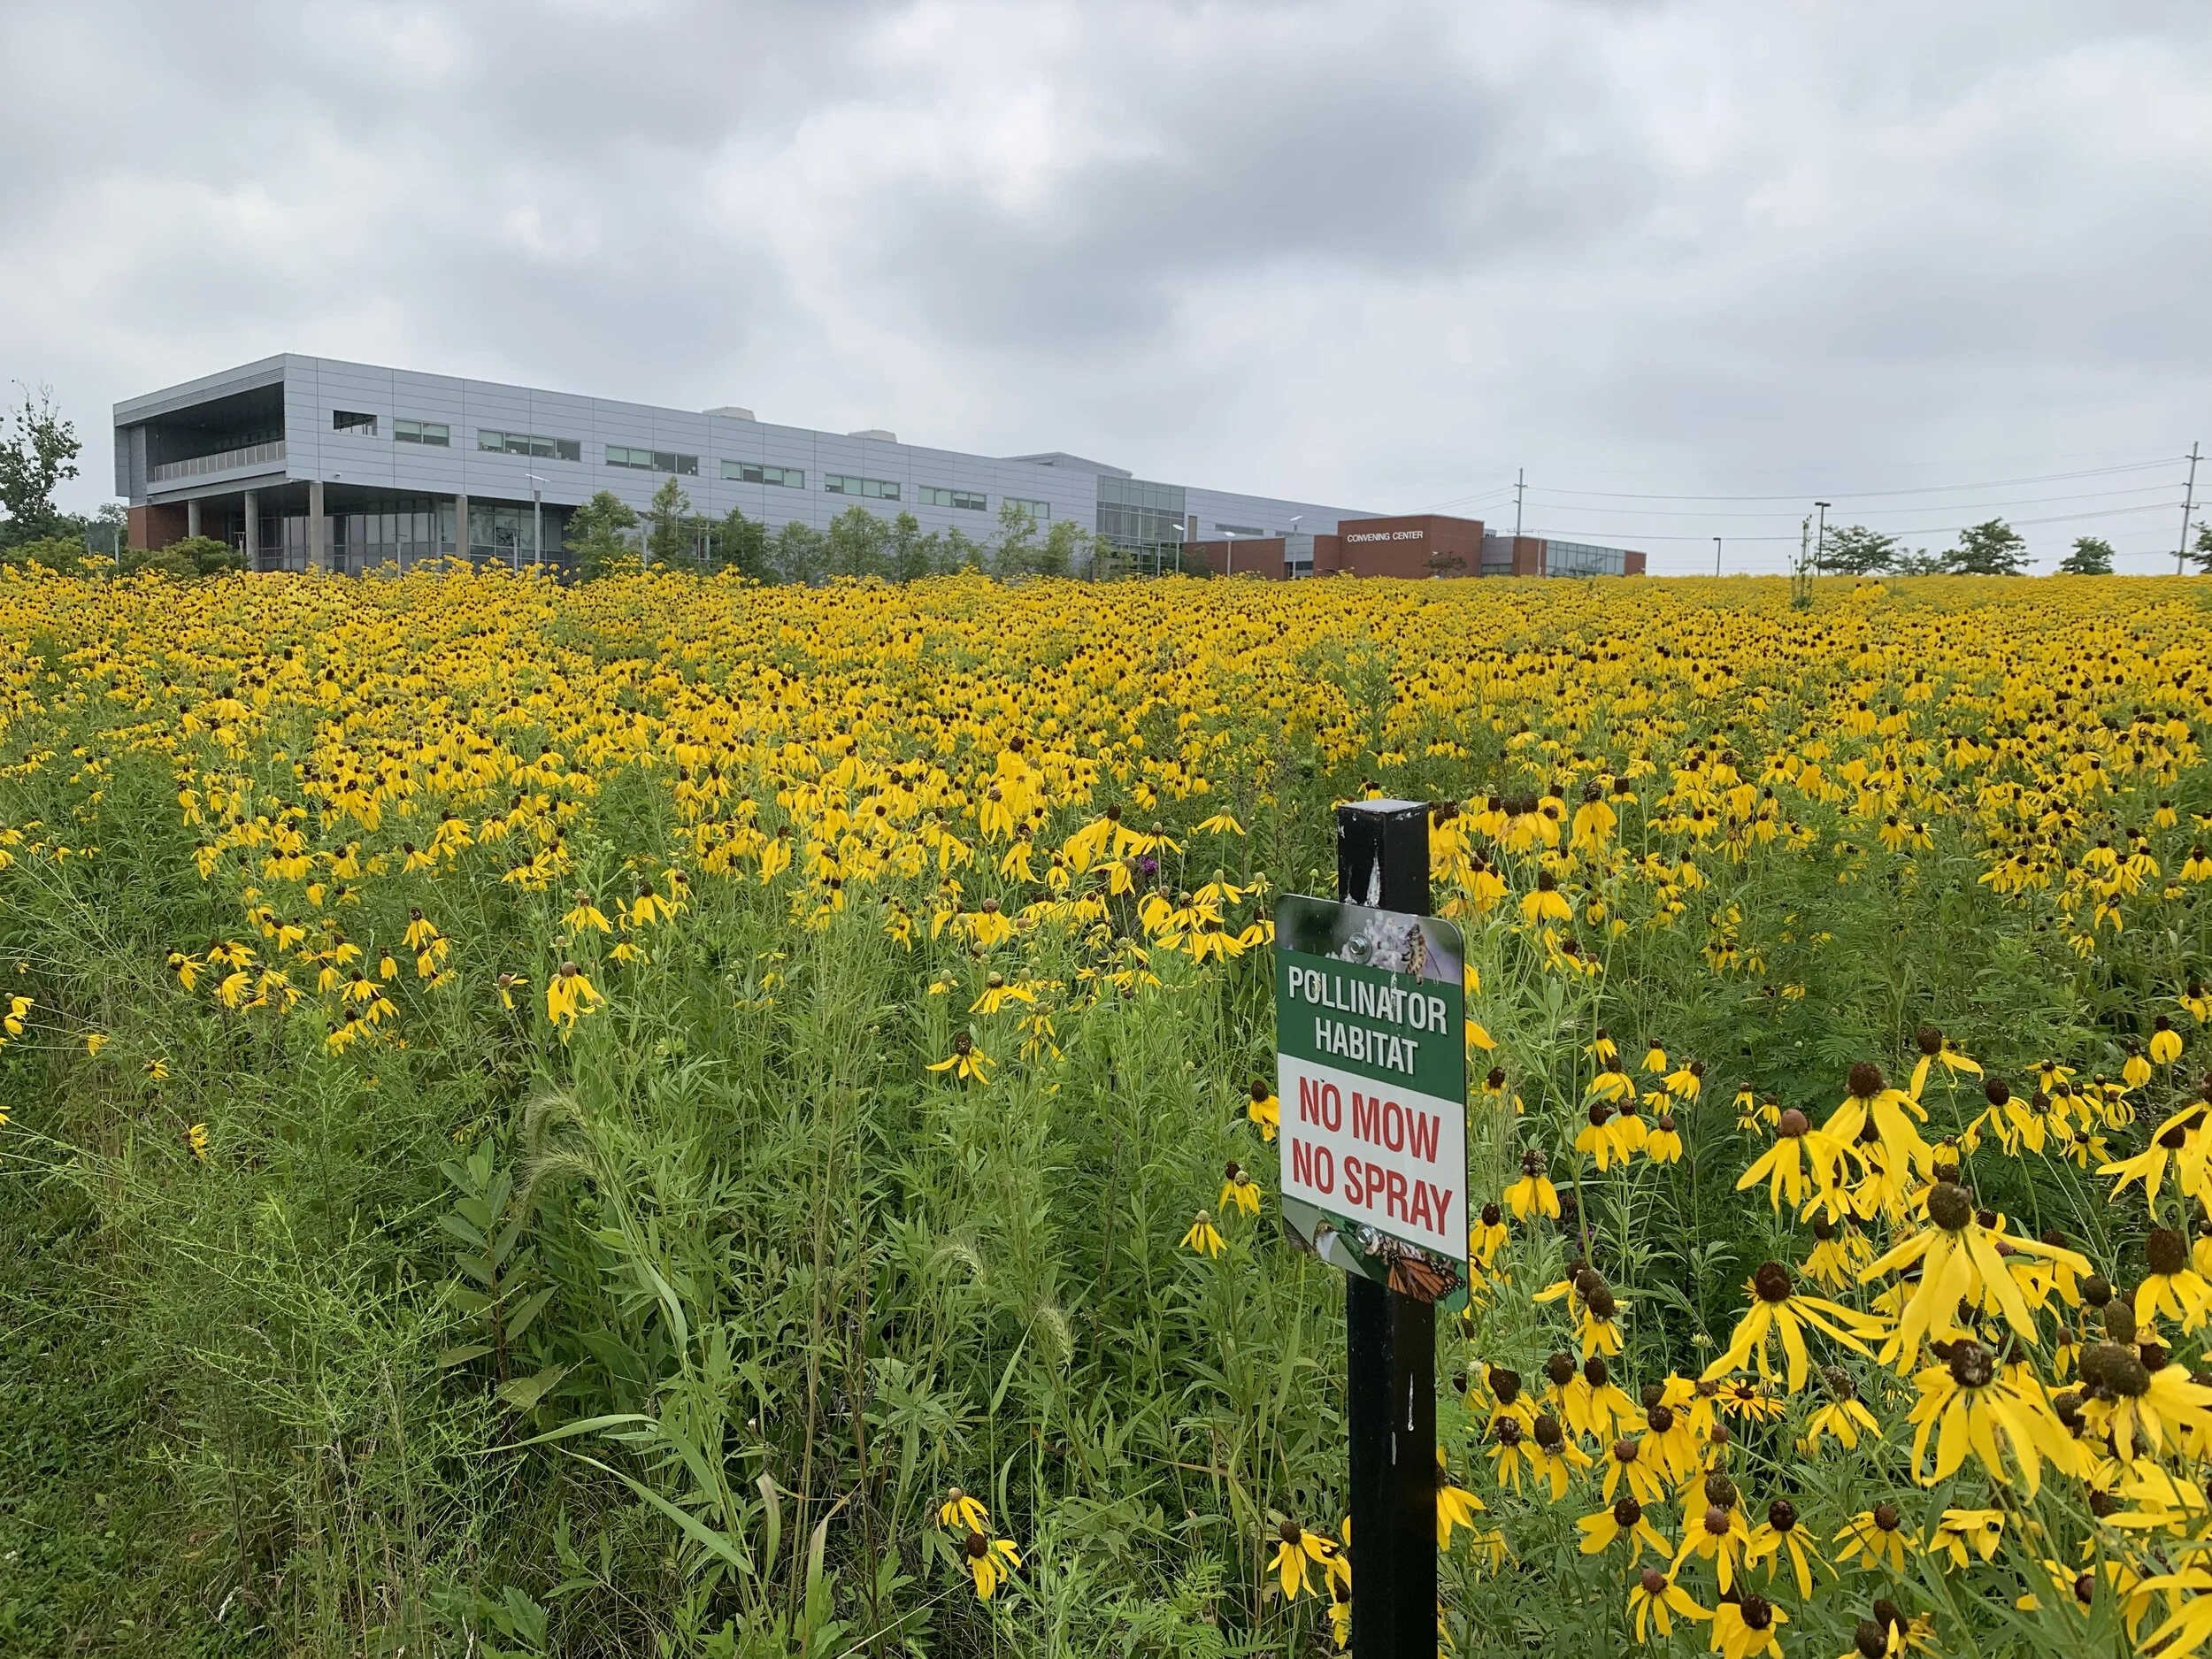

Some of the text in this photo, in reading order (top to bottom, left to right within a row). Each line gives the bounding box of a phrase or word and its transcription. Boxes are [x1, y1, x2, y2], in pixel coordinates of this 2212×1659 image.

[1347, 531, 1424, 542] CONVENING CENTER
[1288, 965, 1448, 1034] POLLINATOR
[1315, 1017, 1418, 1075] HABITAT
[1299, 1076, 1440, 1164] NO MOW
[1292, 1138, 1453, 1236] NO SPRAY
